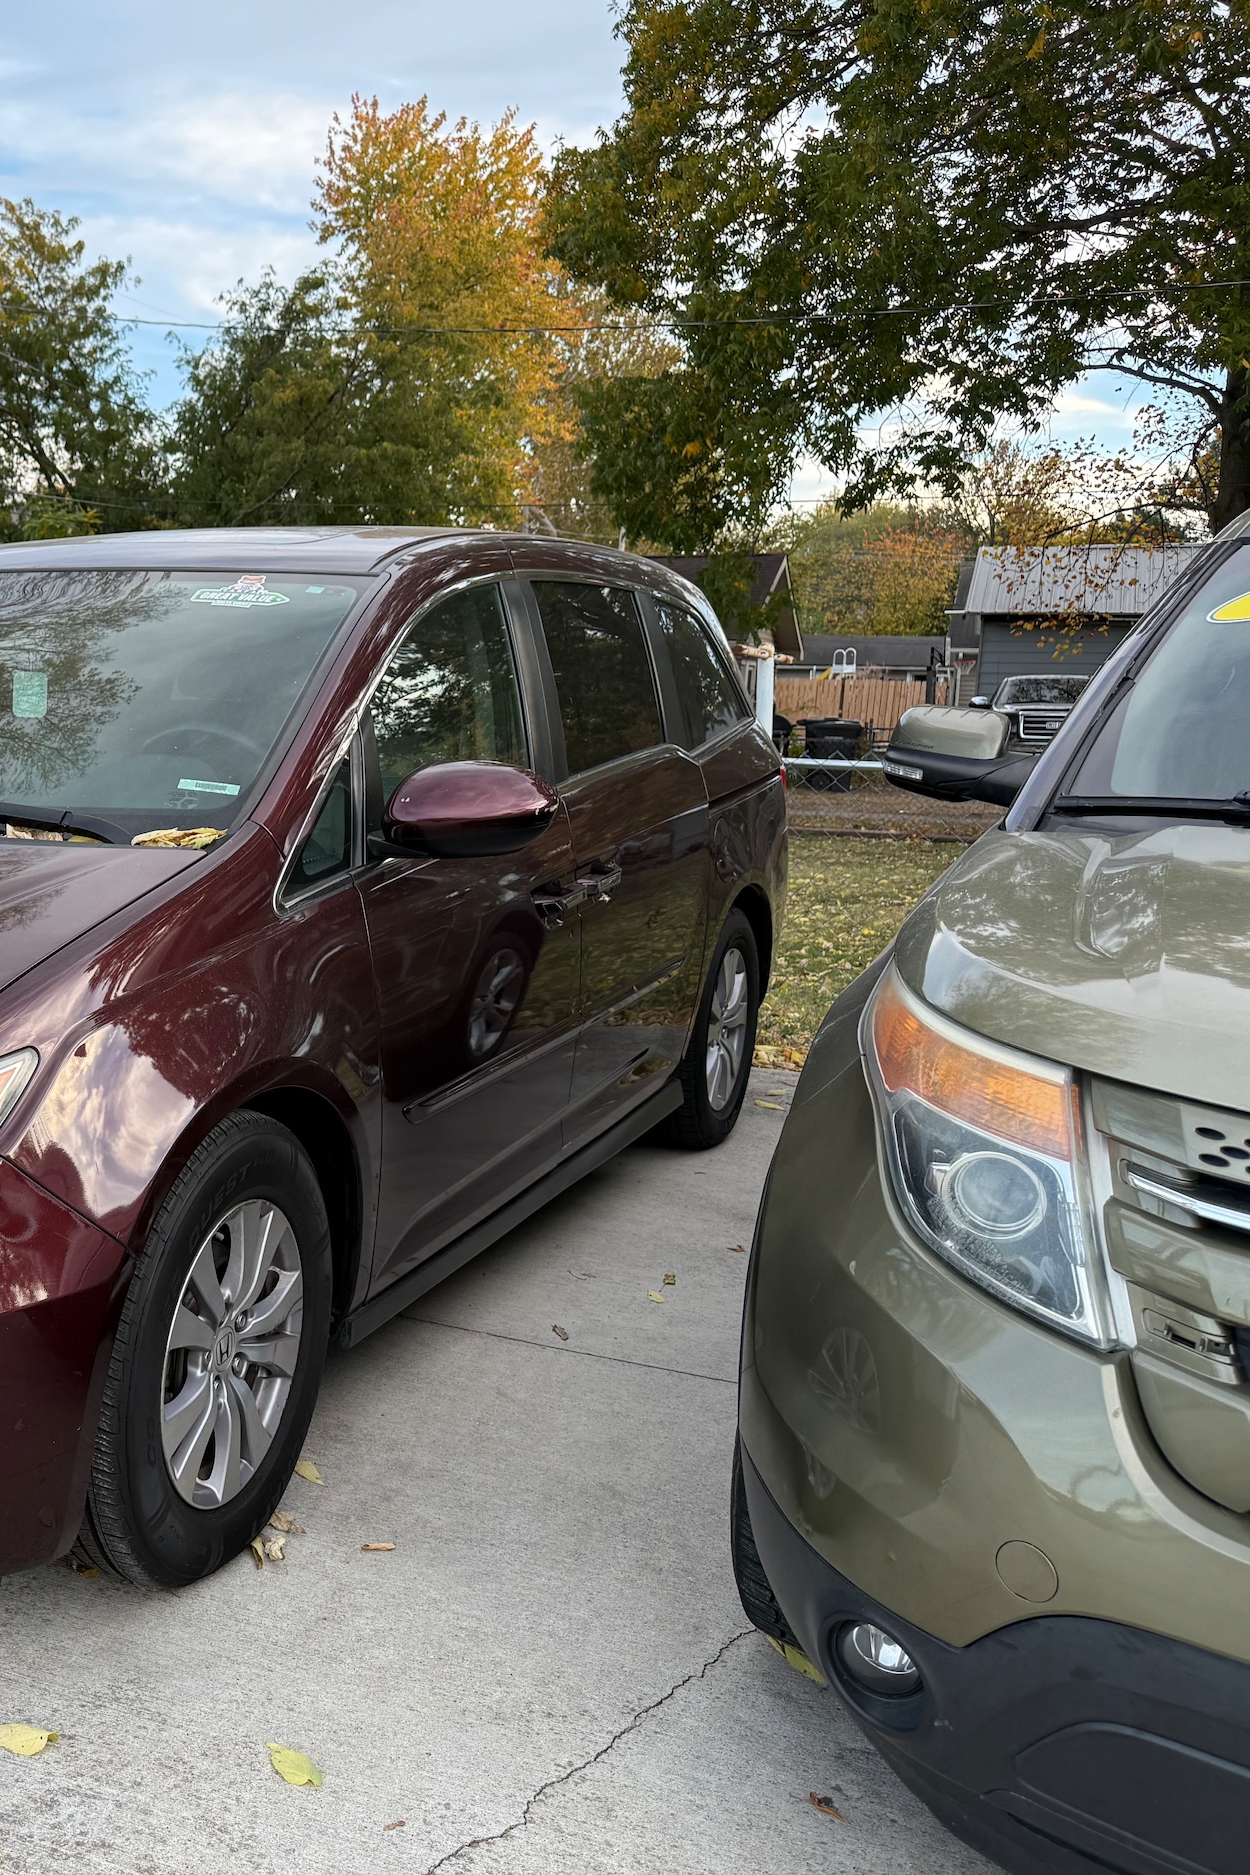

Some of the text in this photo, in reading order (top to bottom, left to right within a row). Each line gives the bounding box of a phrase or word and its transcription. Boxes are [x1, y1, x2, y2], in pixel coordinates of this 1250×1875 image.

[199, 591, 276, 602] GREAT VALUE
[189, 1164, 250, 1255] QUEST
